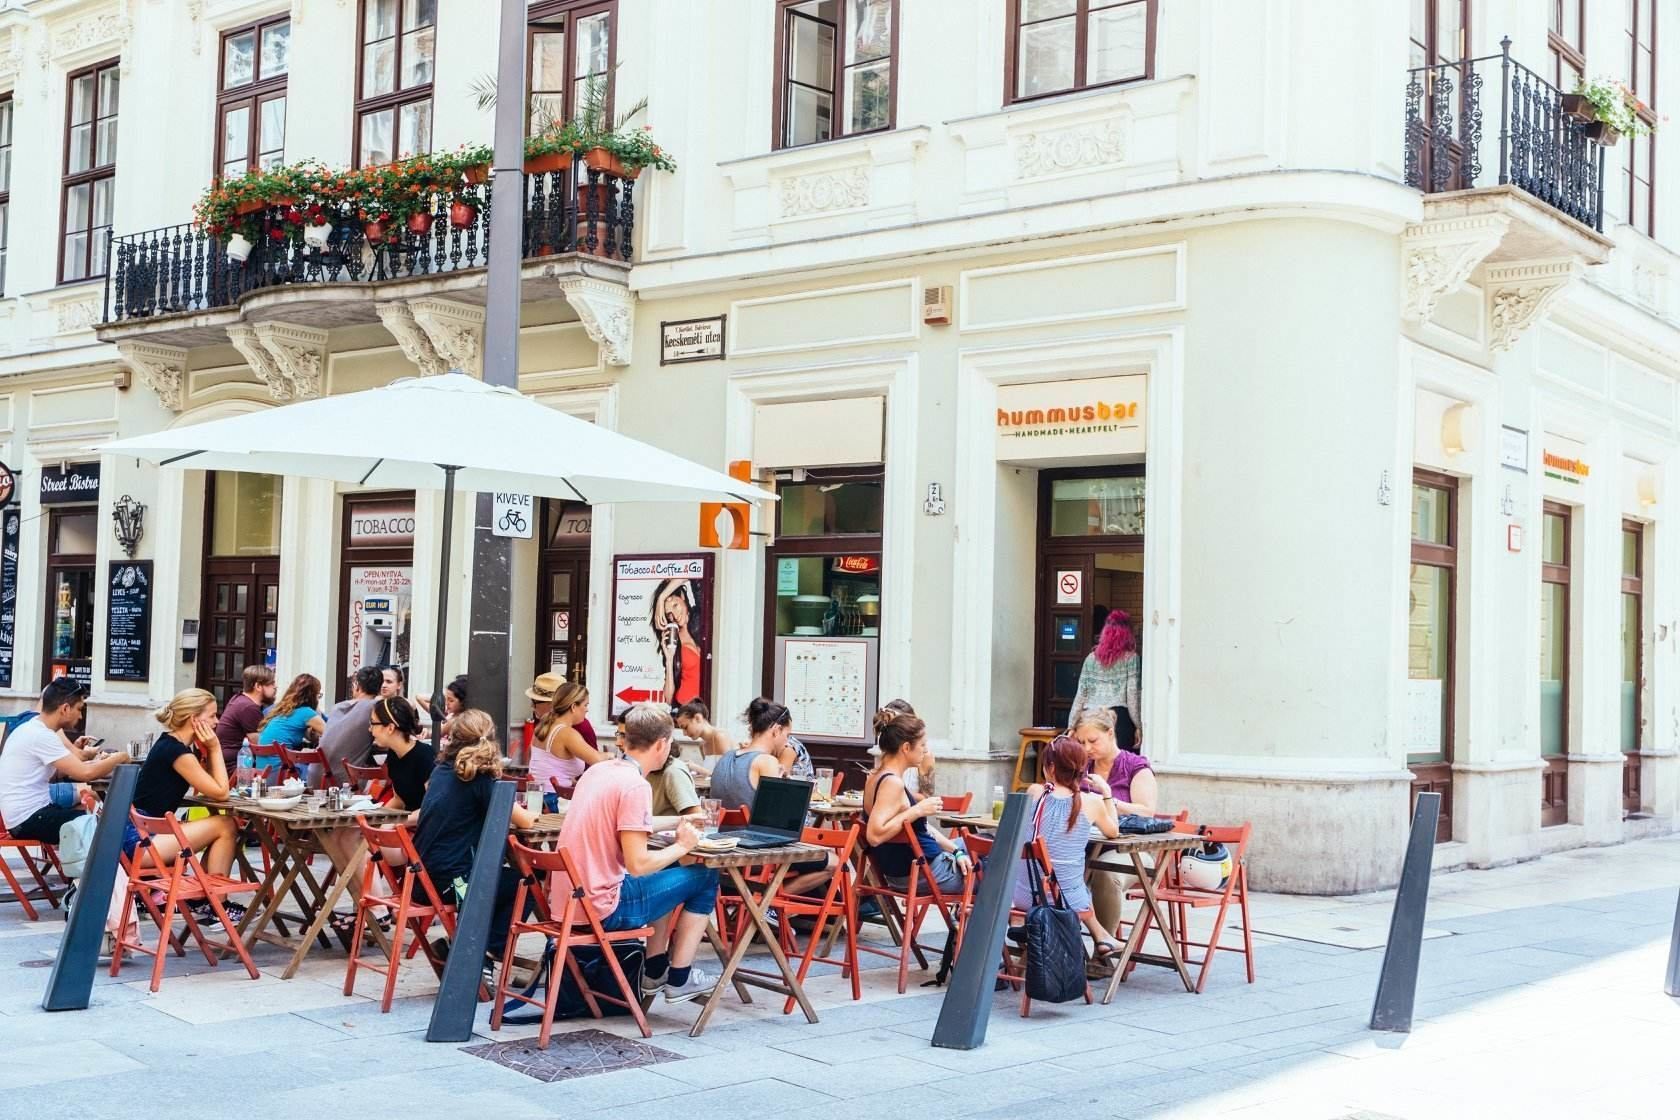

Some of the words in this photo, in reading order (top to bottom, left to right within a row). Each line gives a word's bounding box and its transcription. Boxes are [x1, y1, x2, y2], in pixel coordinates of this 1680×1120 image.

[664, 332, 703, 348] Kecskeméti
[705, 331, 721, 343] utca
[997, 402, 1138, 426] hummusbar
[1015, 429, 1064, 438] HANDMADE
[1069, 424, 1118, 435] HEARTFELT
[41, 475, 68, 492] Street
[69, 473, 99, 491] Bistro
[354, 518, 415, 535] TOBACCO
[366, 601, 377, 609] EUR
[377, 601, 388, 609] HUF
